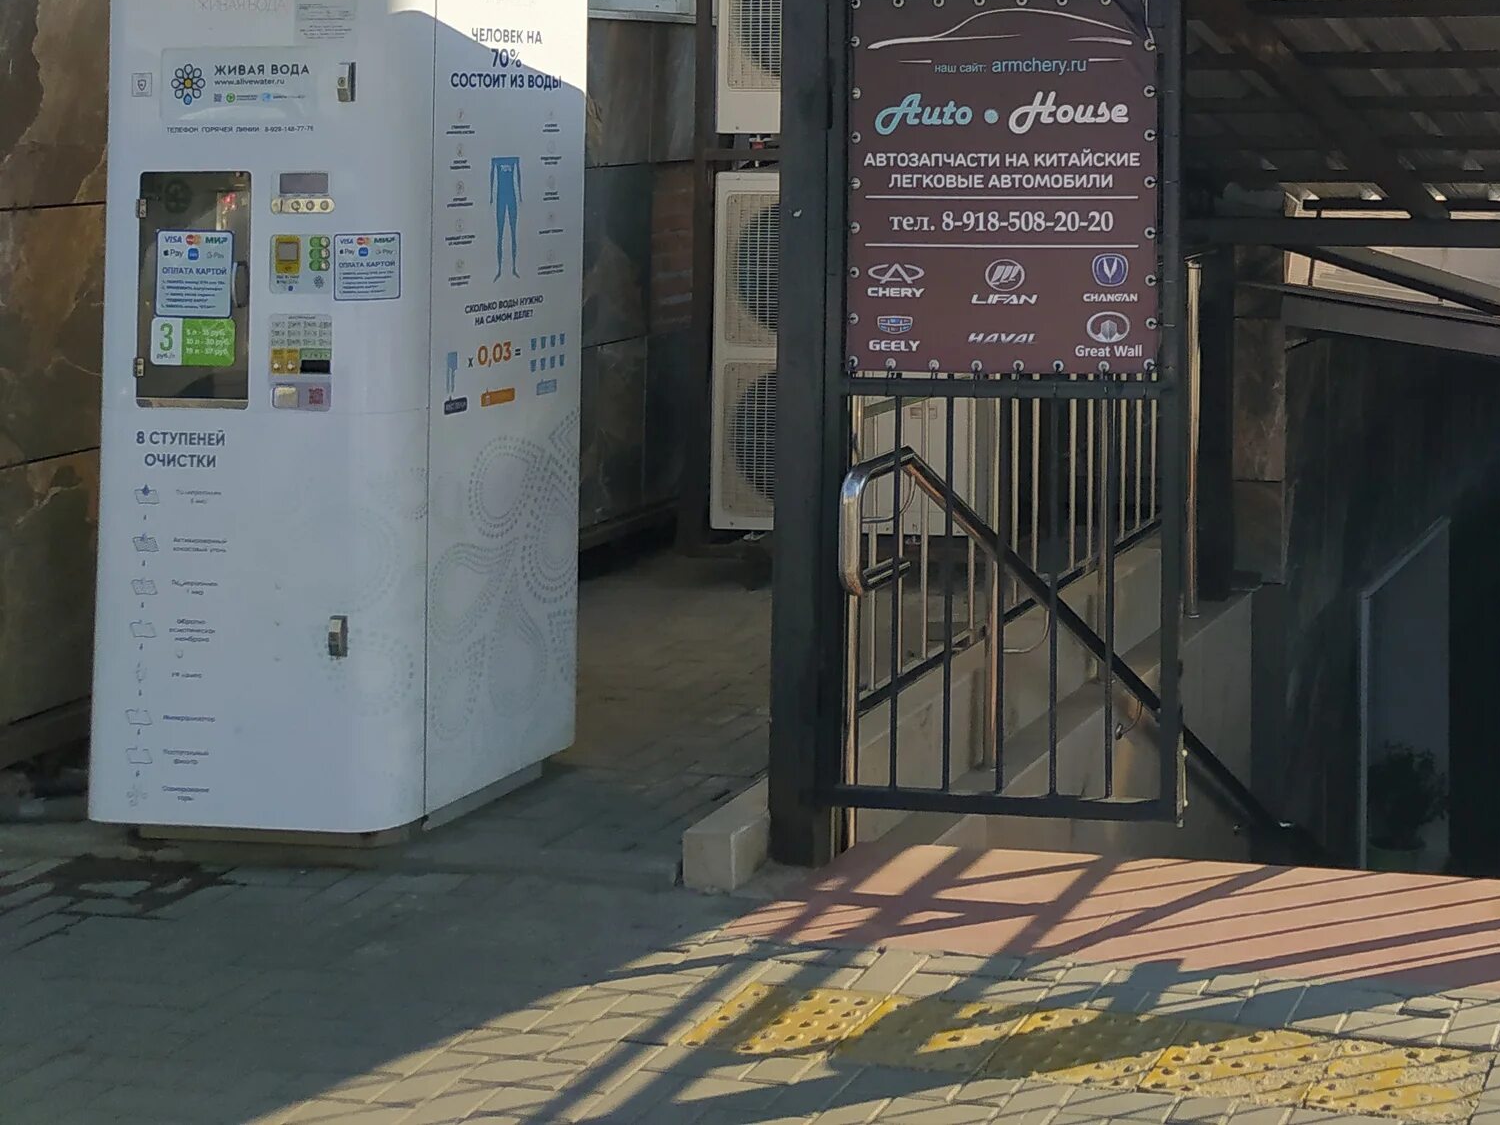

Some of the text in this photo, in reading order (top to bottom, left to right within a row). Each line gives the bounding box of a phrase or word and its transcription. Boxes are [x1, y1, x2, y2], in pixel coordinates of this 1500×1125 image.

[471, 27, 543, 44] ЧЕЛОВЕК НА
[491, 48, 522, 68] 70%
[214, 63, 310, 76] ЖИВАЯ ВОДА
[934, 58, 1088, 75] наш сайт: armchery.ru
[450, 72, 562, 91] СОСТОИТ ИЗ ВОДЫ
[874, 90, 1130, 135] Auto House
[202, 125, 233, 133] ГОРЯЧЕЙ
[235, 125, 260, 133] ЛИНИИ
[863, 148, 1140, 168] АВТОЗАПЧАСТИ НА КИТАЙСКИЕ
[888, 174, 1113, 189] ЛЕГКОВЫЕ АВТОМОБИЛИ
[889, 210, 1114, 232] тел. 8-918-508-20-20
[164, 236, 182, 244] VISA
[205, 236, 228, 244] МИР
[162, 266, 227, 275] ОПЛАТА КАРТОЙ
[867, 287, 925, 298] CHERY
[971, 293, 1038, 305] LIFAN
[1083, 293, 1138, 302] CHANGAN
[464, 300, 497, 314] СКОЛЬКО
[498, 298, 519, 309] ВОДЫ
[474, 316, 485, 326] НА
[486, 312, 513, 324] САМОМ
[159, 322, 173, 351] 3
[868, 340, 921, 352] GEELY
[1075, 345, 1143, 357] Great Wall
[477, 341, 512, 368] 0,03
[136, 430, 226, 446] 8 СТУПЕНЕЙ
[144, 453, 217, 468] ОЧИСТКИ
